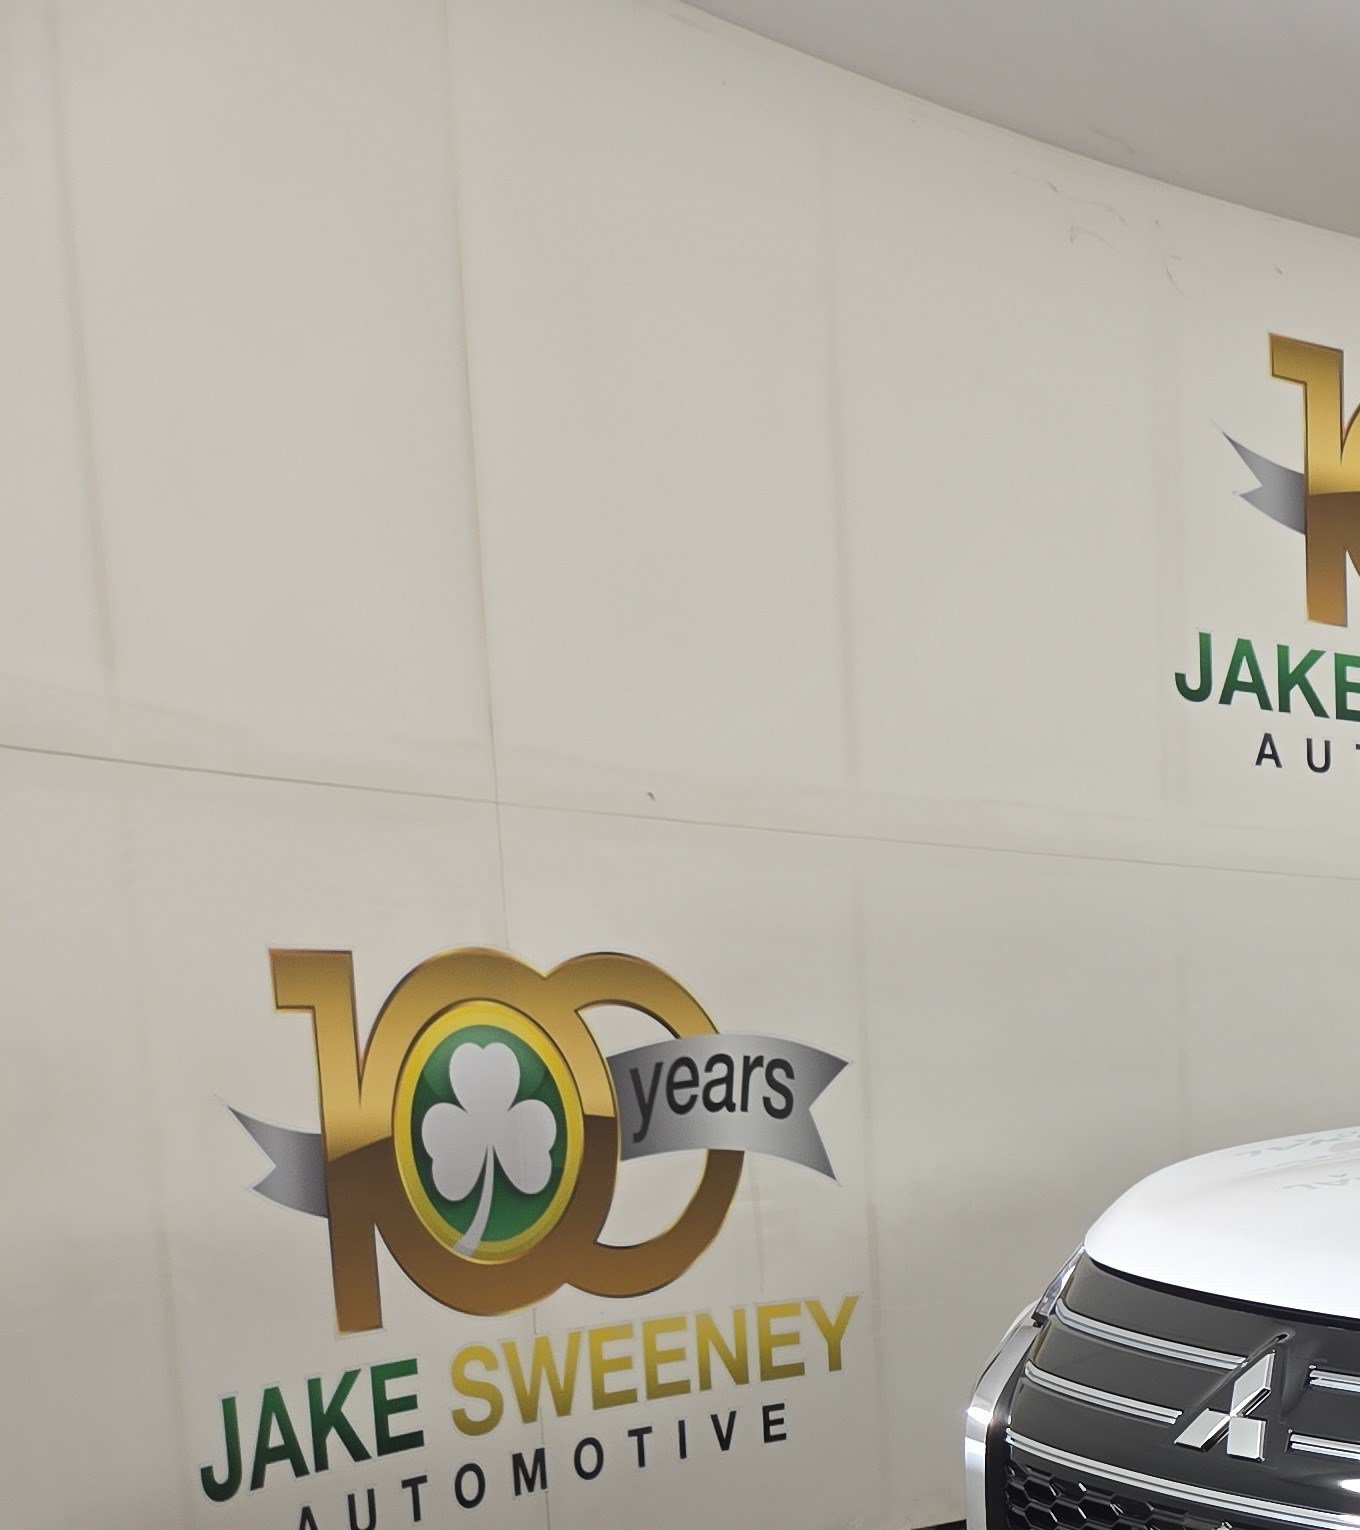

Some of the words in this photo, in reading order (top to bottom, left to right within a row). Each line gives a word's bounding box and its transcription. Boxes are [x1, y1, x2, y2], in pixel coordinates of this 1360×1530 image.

[269, 946, 745, 1336] 100
[629, 1053, 796, 1143] years
[200, 1357, 425, 1503] JAKE
[450, 1294, 860, 1437] SWEENEY
